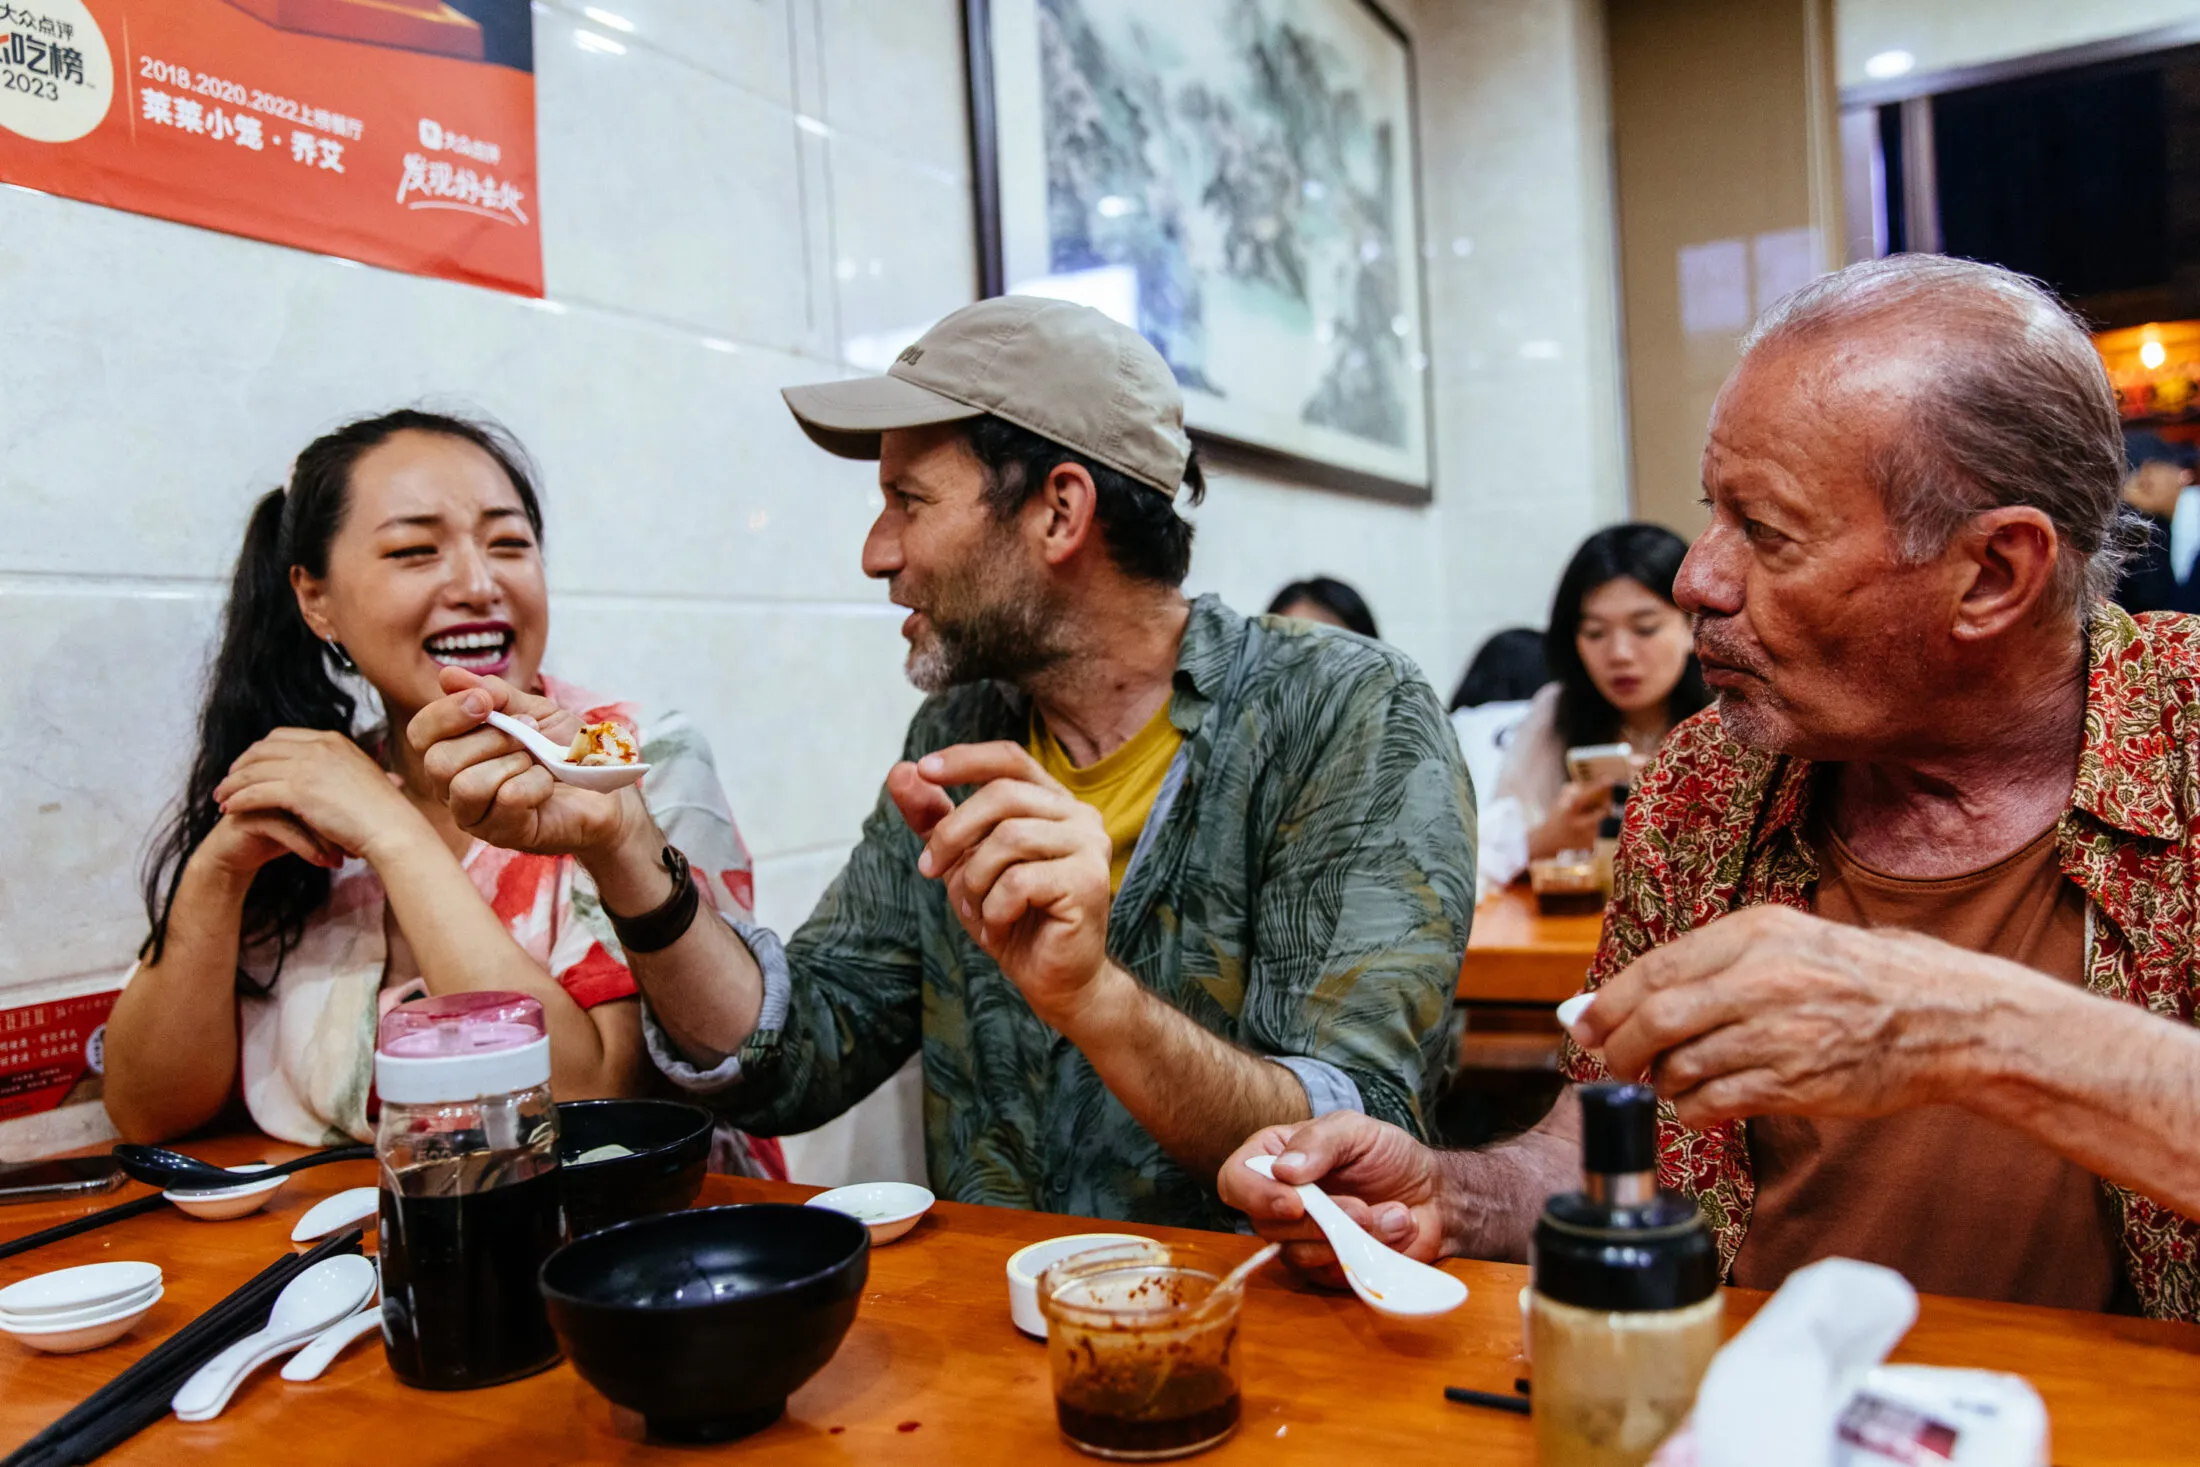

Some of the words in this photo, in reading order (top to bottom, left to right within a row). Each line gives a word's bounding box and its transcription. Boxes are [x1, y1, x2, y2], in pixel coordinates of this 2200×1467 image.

[0, 3, 74, 41] 大众点评
[3, 69, 59, 101] 2023
